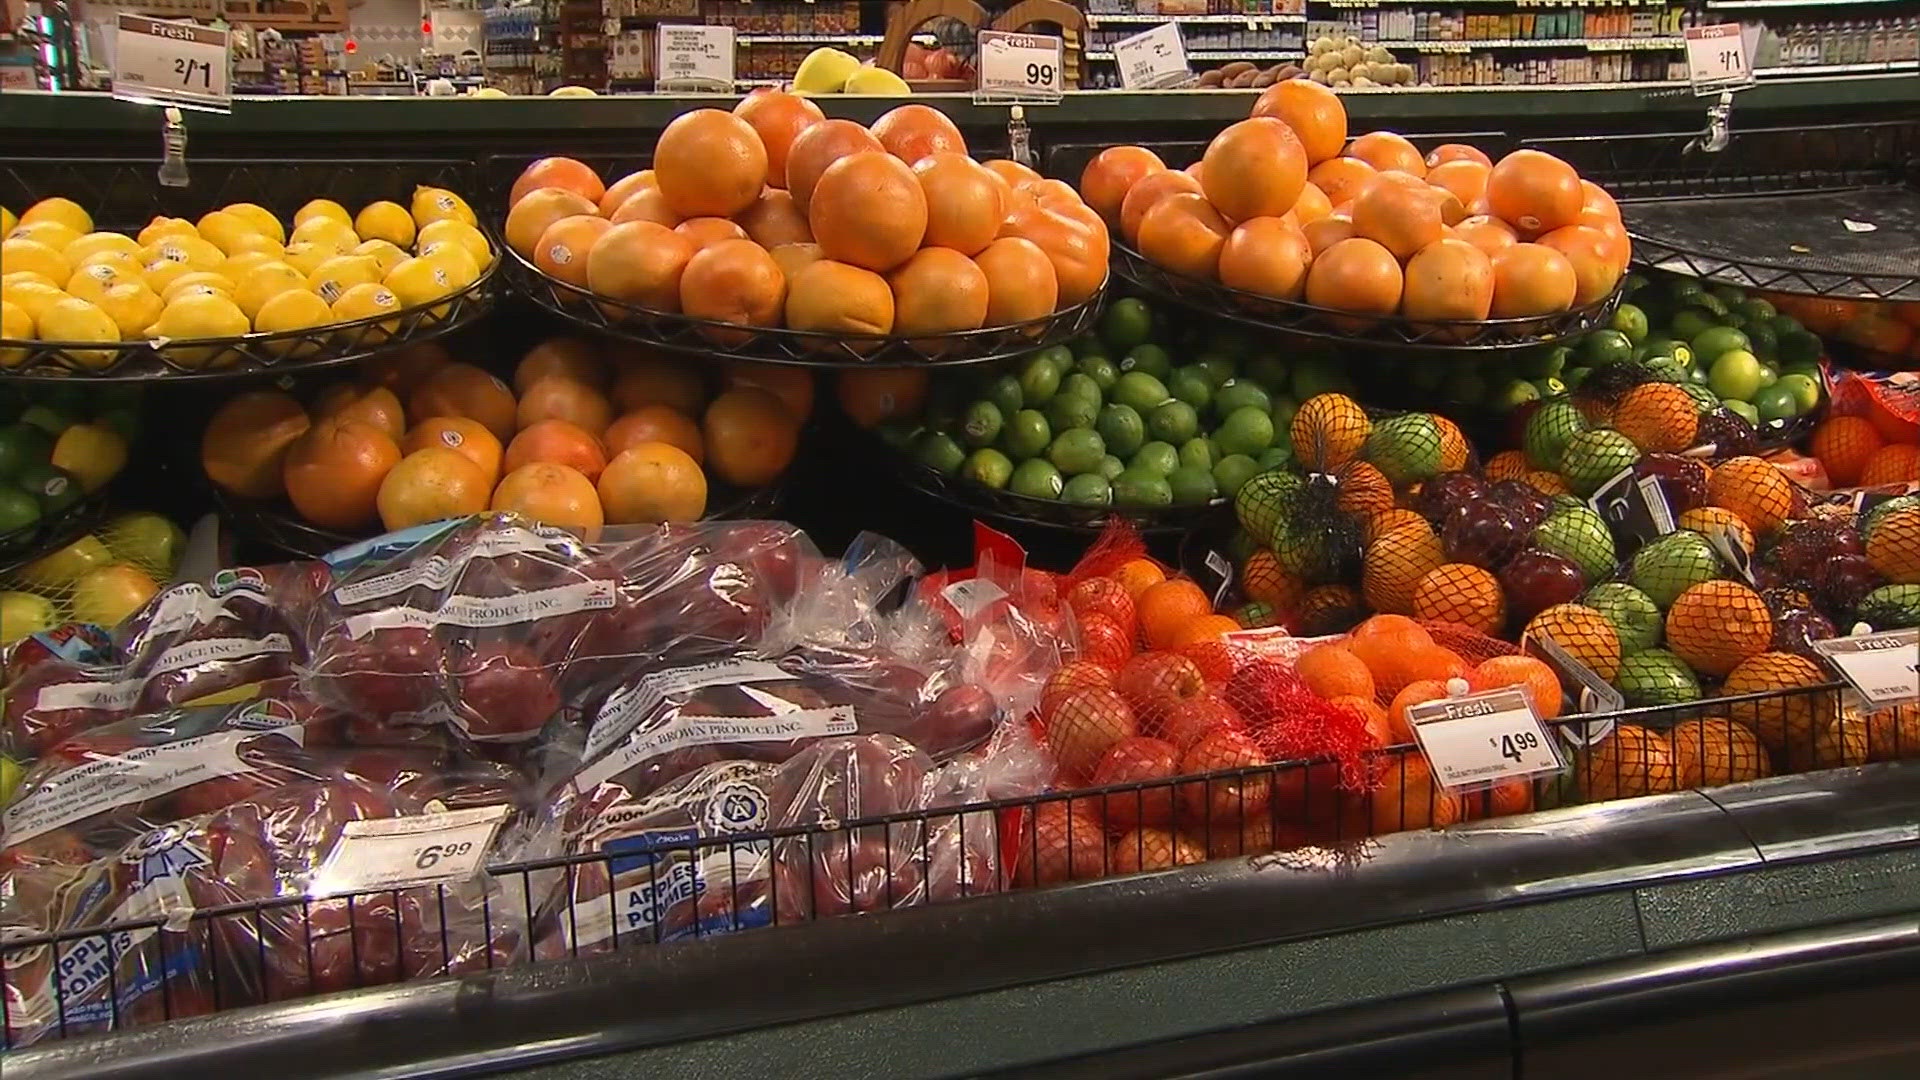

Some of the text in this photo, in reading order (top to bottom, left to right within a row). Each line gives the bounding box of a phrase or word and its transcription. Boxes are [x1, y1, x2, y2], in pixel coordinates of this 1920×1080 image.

[151, 23, 195, 40] Fresh
[1701, 28, 1725, 39] Fresh
[1004, 35, 1036, 48] Fresh
[1855, 637, 1902, 651] Fresh
[1445, 699, 1494, 719] Fresh
[623, 739, 656, 764] JACK
[657, 725, 707, 745] BROWN
[709, 724, 774, 735] PRODUCE
[629, 864, 699, 908] APPLES
